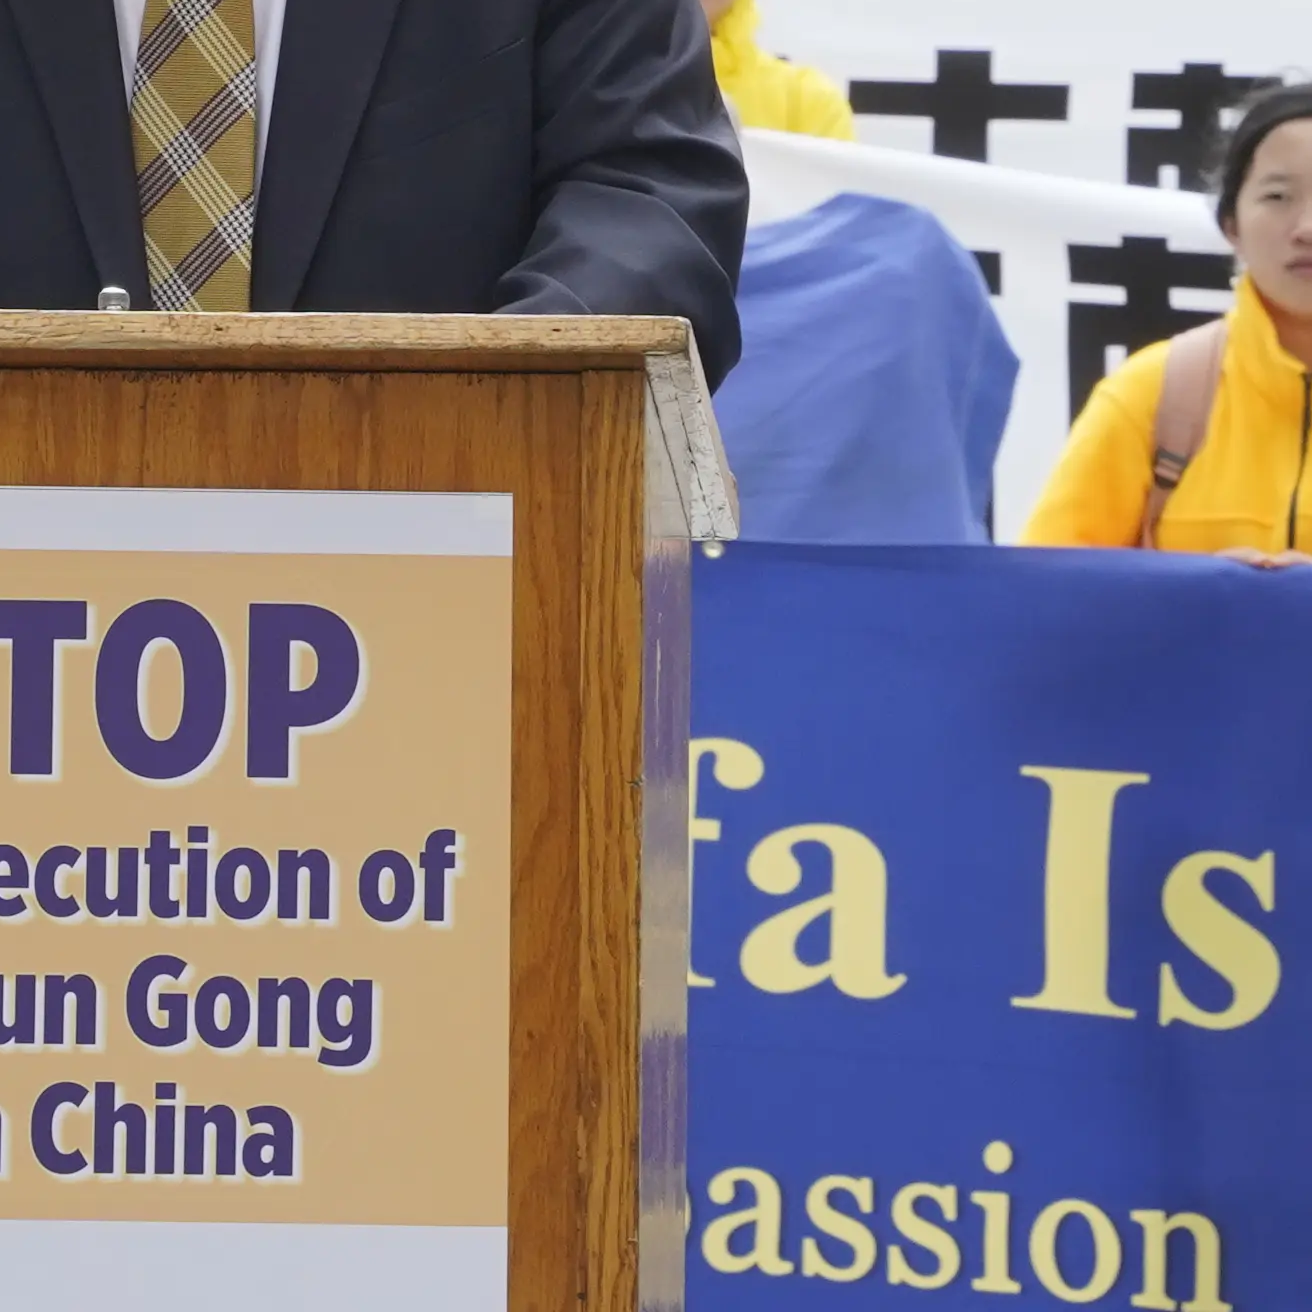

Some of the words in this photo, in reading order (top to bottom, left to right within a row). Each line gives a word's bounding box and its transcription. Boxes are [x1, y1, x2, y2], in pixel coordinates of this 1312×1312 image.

[357, 829, 456, 923] of
[1010, 765, 1282, 1031] Is
[125, 954, 375, 1067] Gong
[30, 1082, 294, 1177] China
[686, 1141, 1233, 1312] assion
